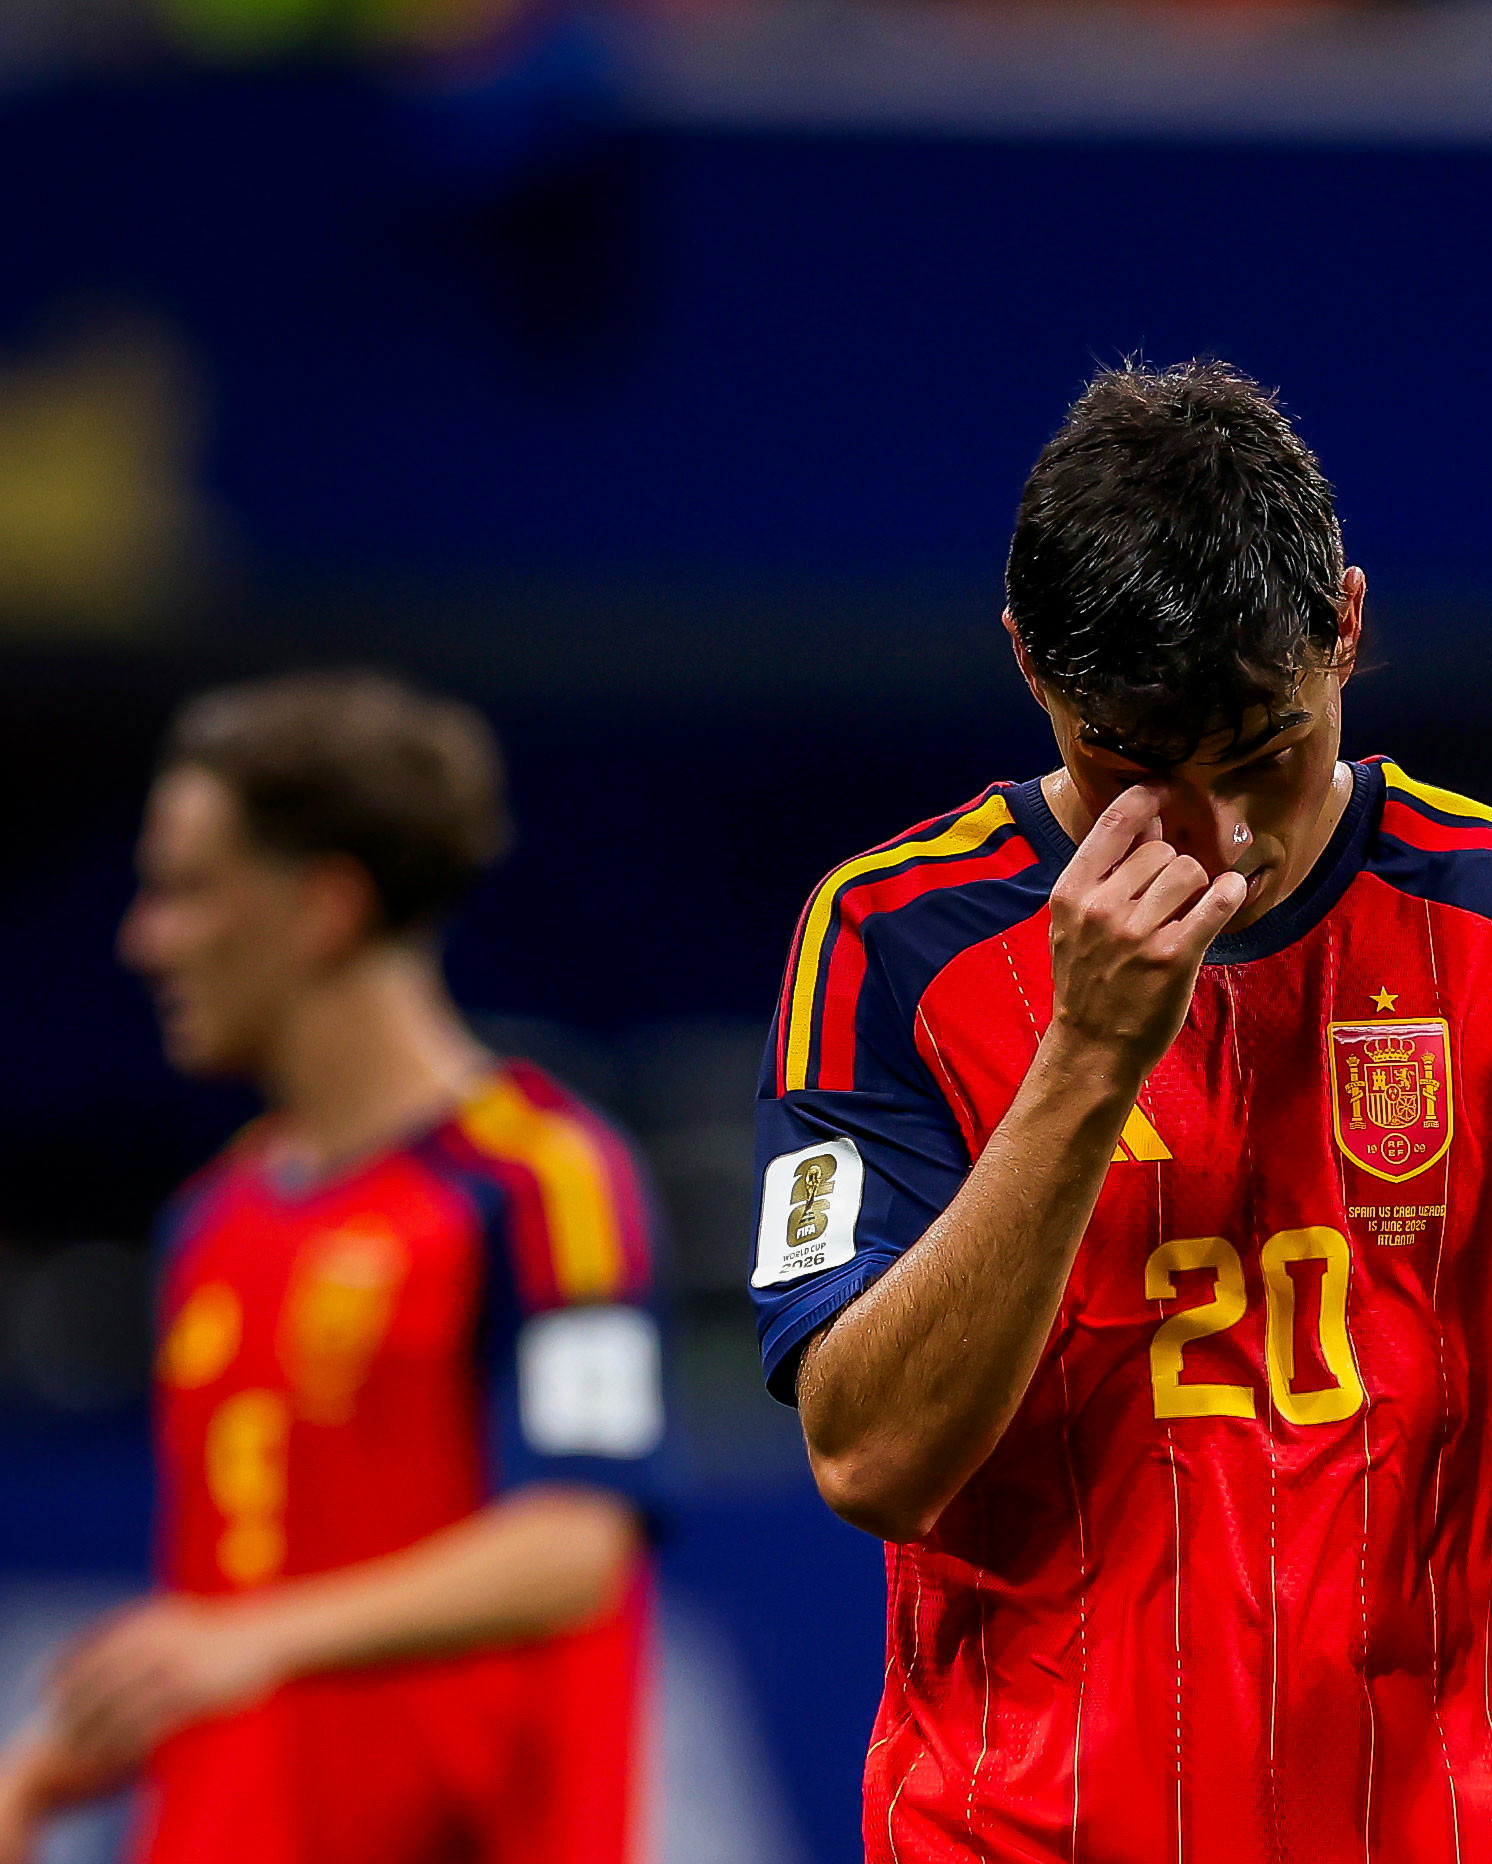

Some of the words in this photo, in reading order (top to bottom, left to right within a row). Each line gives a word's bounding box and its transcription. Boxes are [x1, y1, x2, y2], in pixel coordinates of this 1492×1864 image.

[1348, 1206, 1376, 1218] SPAIN
[1378, 1206, 1391, 1218] VS
[1393, 1205, 1417, 1218] CABO
[796, 1223, 817, 1240] FIFA
[1368, 1220, 1378, 1232] 15
[1380, 1220, 1403, 1232] JUNE
[1405, 1219, 1427, 1232] 2026
[1377, 1233, 1415, 1246] ATLANTA
[783, 1246, 810, 1262] WORLD
[810, 1242, 827, 1254] CUP
[779, 1253, 825, 1274] 2026
[1144, 1225, 1364, 1426] 20
